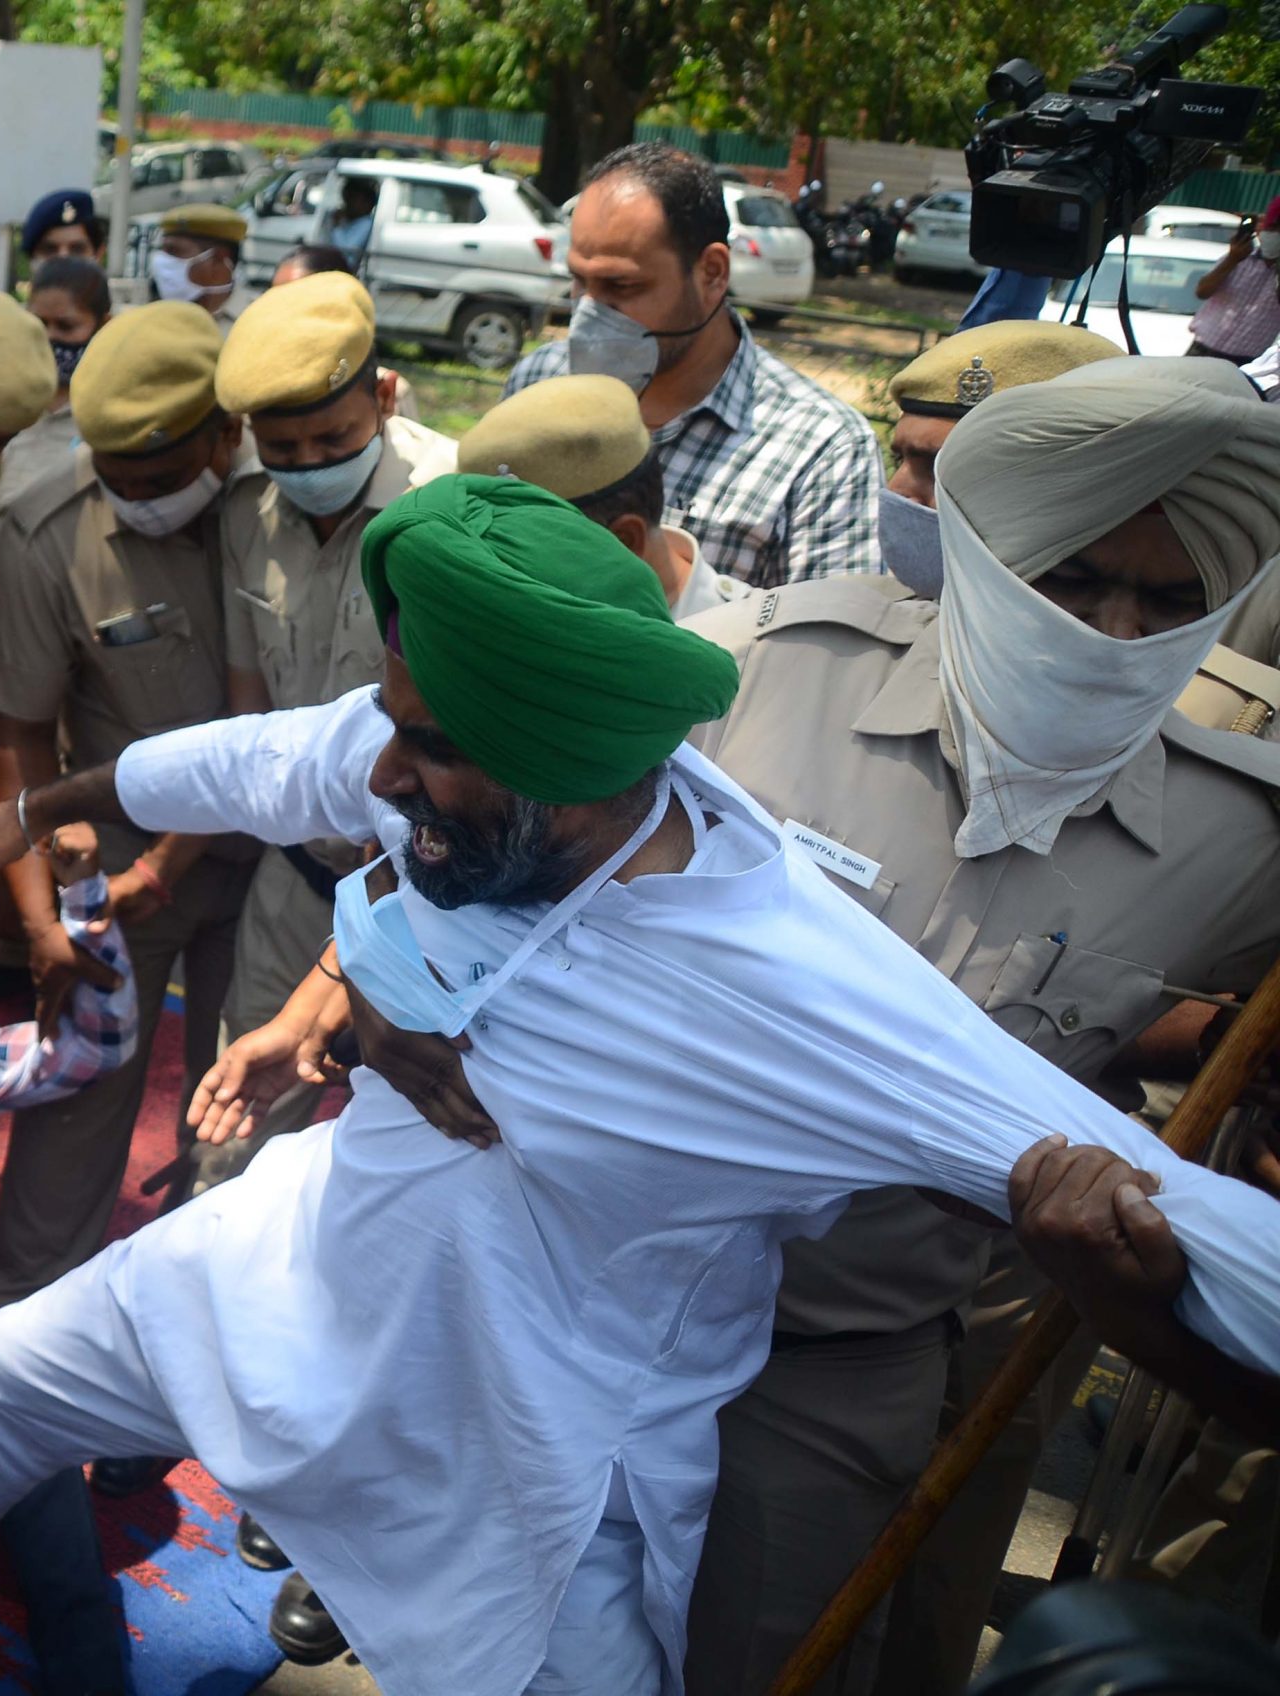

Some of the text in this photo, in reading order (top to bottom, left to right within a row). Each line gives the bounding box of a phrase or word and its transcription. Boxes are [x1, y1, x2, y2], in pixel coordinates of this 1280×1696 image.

[1180, 103, 1225, 114] XDCAM
[794, 834, 866, 874] AMRITPAL SINGH
